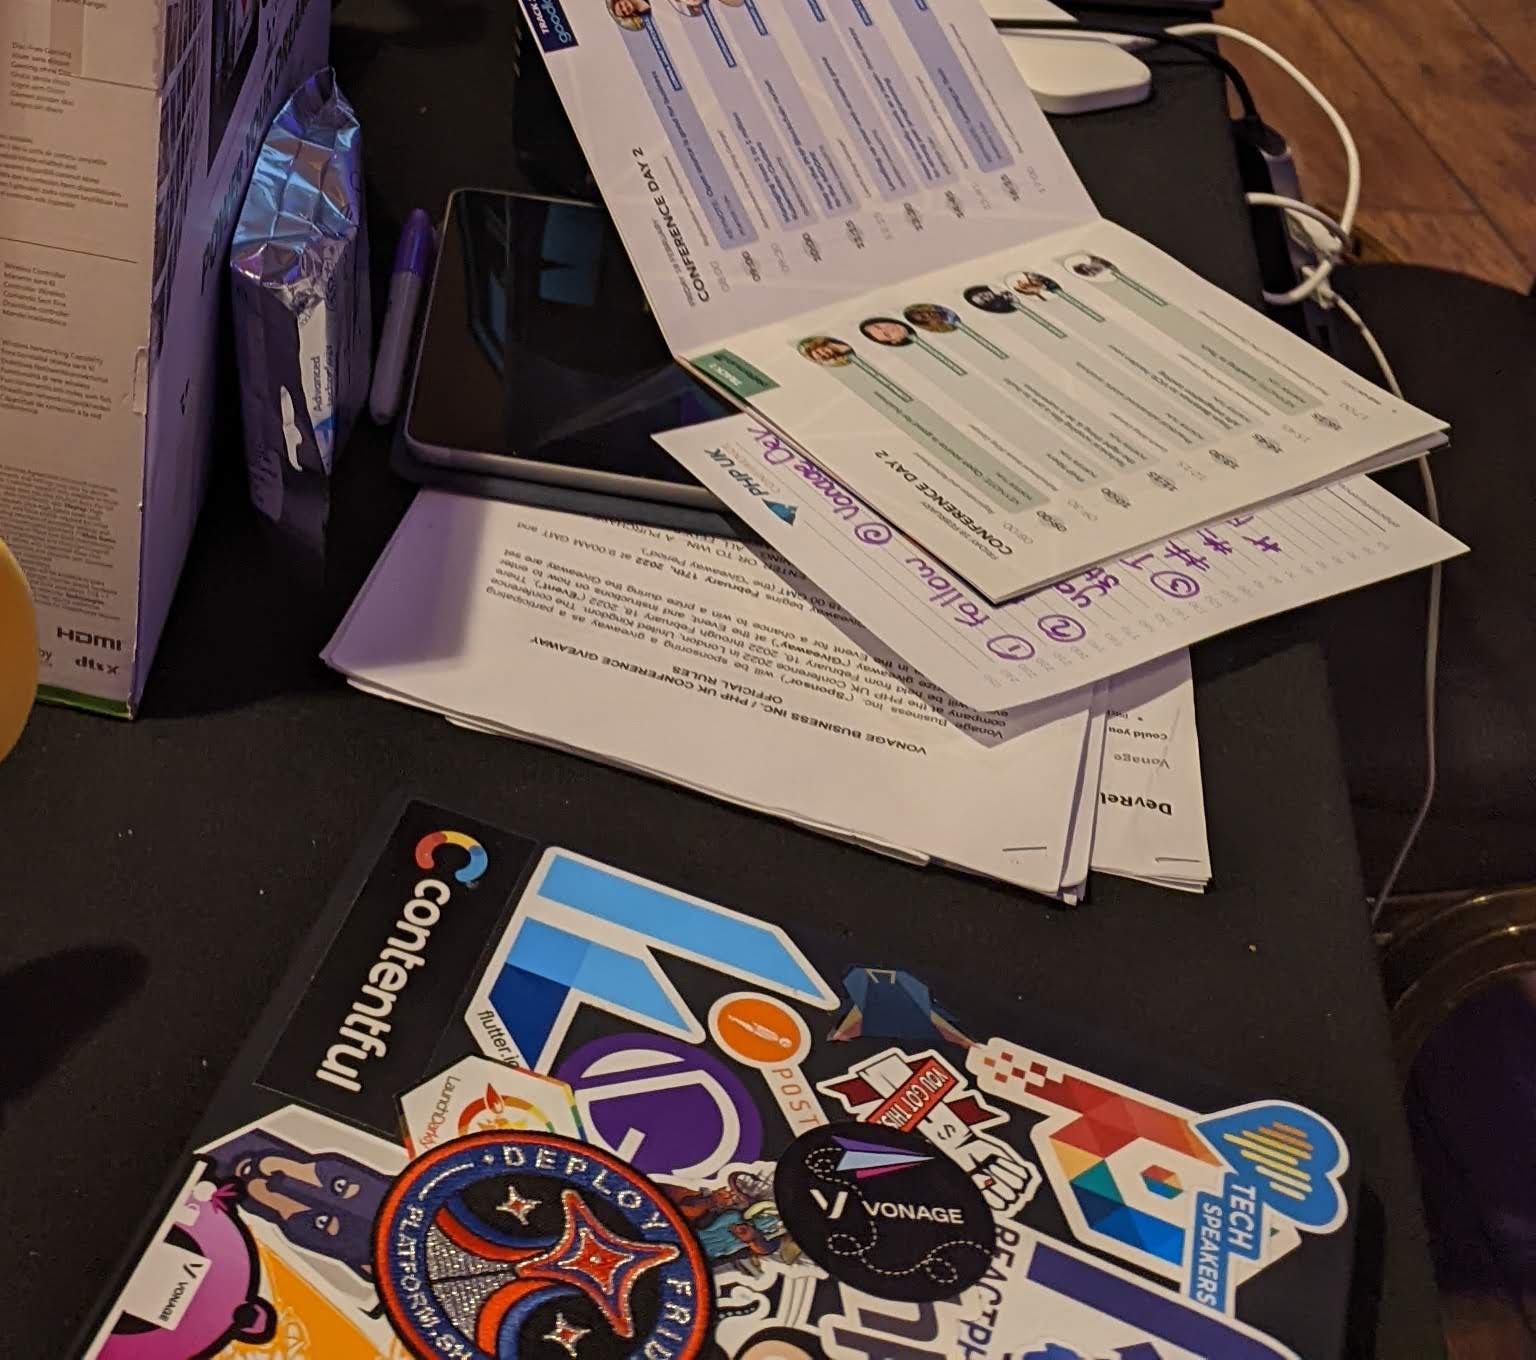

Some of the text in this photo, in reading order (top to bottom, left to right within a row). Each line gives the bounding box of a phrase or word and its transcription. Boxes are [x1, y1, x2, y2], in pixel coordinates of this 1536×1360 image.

[530, 1, 549, 35] TRACK
[631, 145, 711, 304] CONFERENCE DAY 2
[740, 249, 761, 282] 09:00
[306, 355, 324, 411] Advanced
[745, 422, 802, 463] Dev
[702, 441, 772, 502] PHP UK
[879, 454, 919, 485] DAY
[783, 455, 867, 523] Vonage
[909, 479, 1020, 557] CONFERENCE
[541, 528, 569, 542] GMT
[634, 555, 664, 570] 2022
[484, 585, 553, 613] participating
[703, 574, 760, 598] February
[764, 591, 804, 611] begins
[906, 555, 991, 630] Follow
[546, 560, 868, 662] Event chance prize during Giveaway
[57, 626, 122, 651] HDMI
[588, 595, 892, 690] from February 2022 through February 2022
[590, 617, 645, 641] giveaway
[489, 577, 1006, 731] company the PHP UK Conference 2022 London, United The conference
[663, 638, 728, 665] sponsoring
[733, 661, 749, 671] be
[671, 664, 782, 704] OFFICIAL RULES
[753, 667, 774, 679] will
[855, 660, 913, 685] giveaway
[529, 634, 927, 757] VONAGE BUSINESS INC. PHP UK CONFERENCE GIVEAWAY
[890, 704, 947, 727] Business
[954, 718, 1003, 740] Vonage
[1107, 724, 1168, 741] Could you
[1112, 751, 1170, 769] Vonage
[1097, 791, 1173, 816] DevRel
[314, 878, 452, 1093] contentful
[917, 1063, 949, 1095] YOU
[419, 1075, 461, 1149] LaunchDarkly
[899, 1081, 931, 1114] GOT
[503, 1145, 670, 1231] DEPLOY
[863, 1199, 964, 1225] VONAGE
[1227, 1183, 1257, 1251] TECH
[1196, 1201, 1223, 1307] SPEAKERS
[158, 1280, 189, 1322] VONAGE
